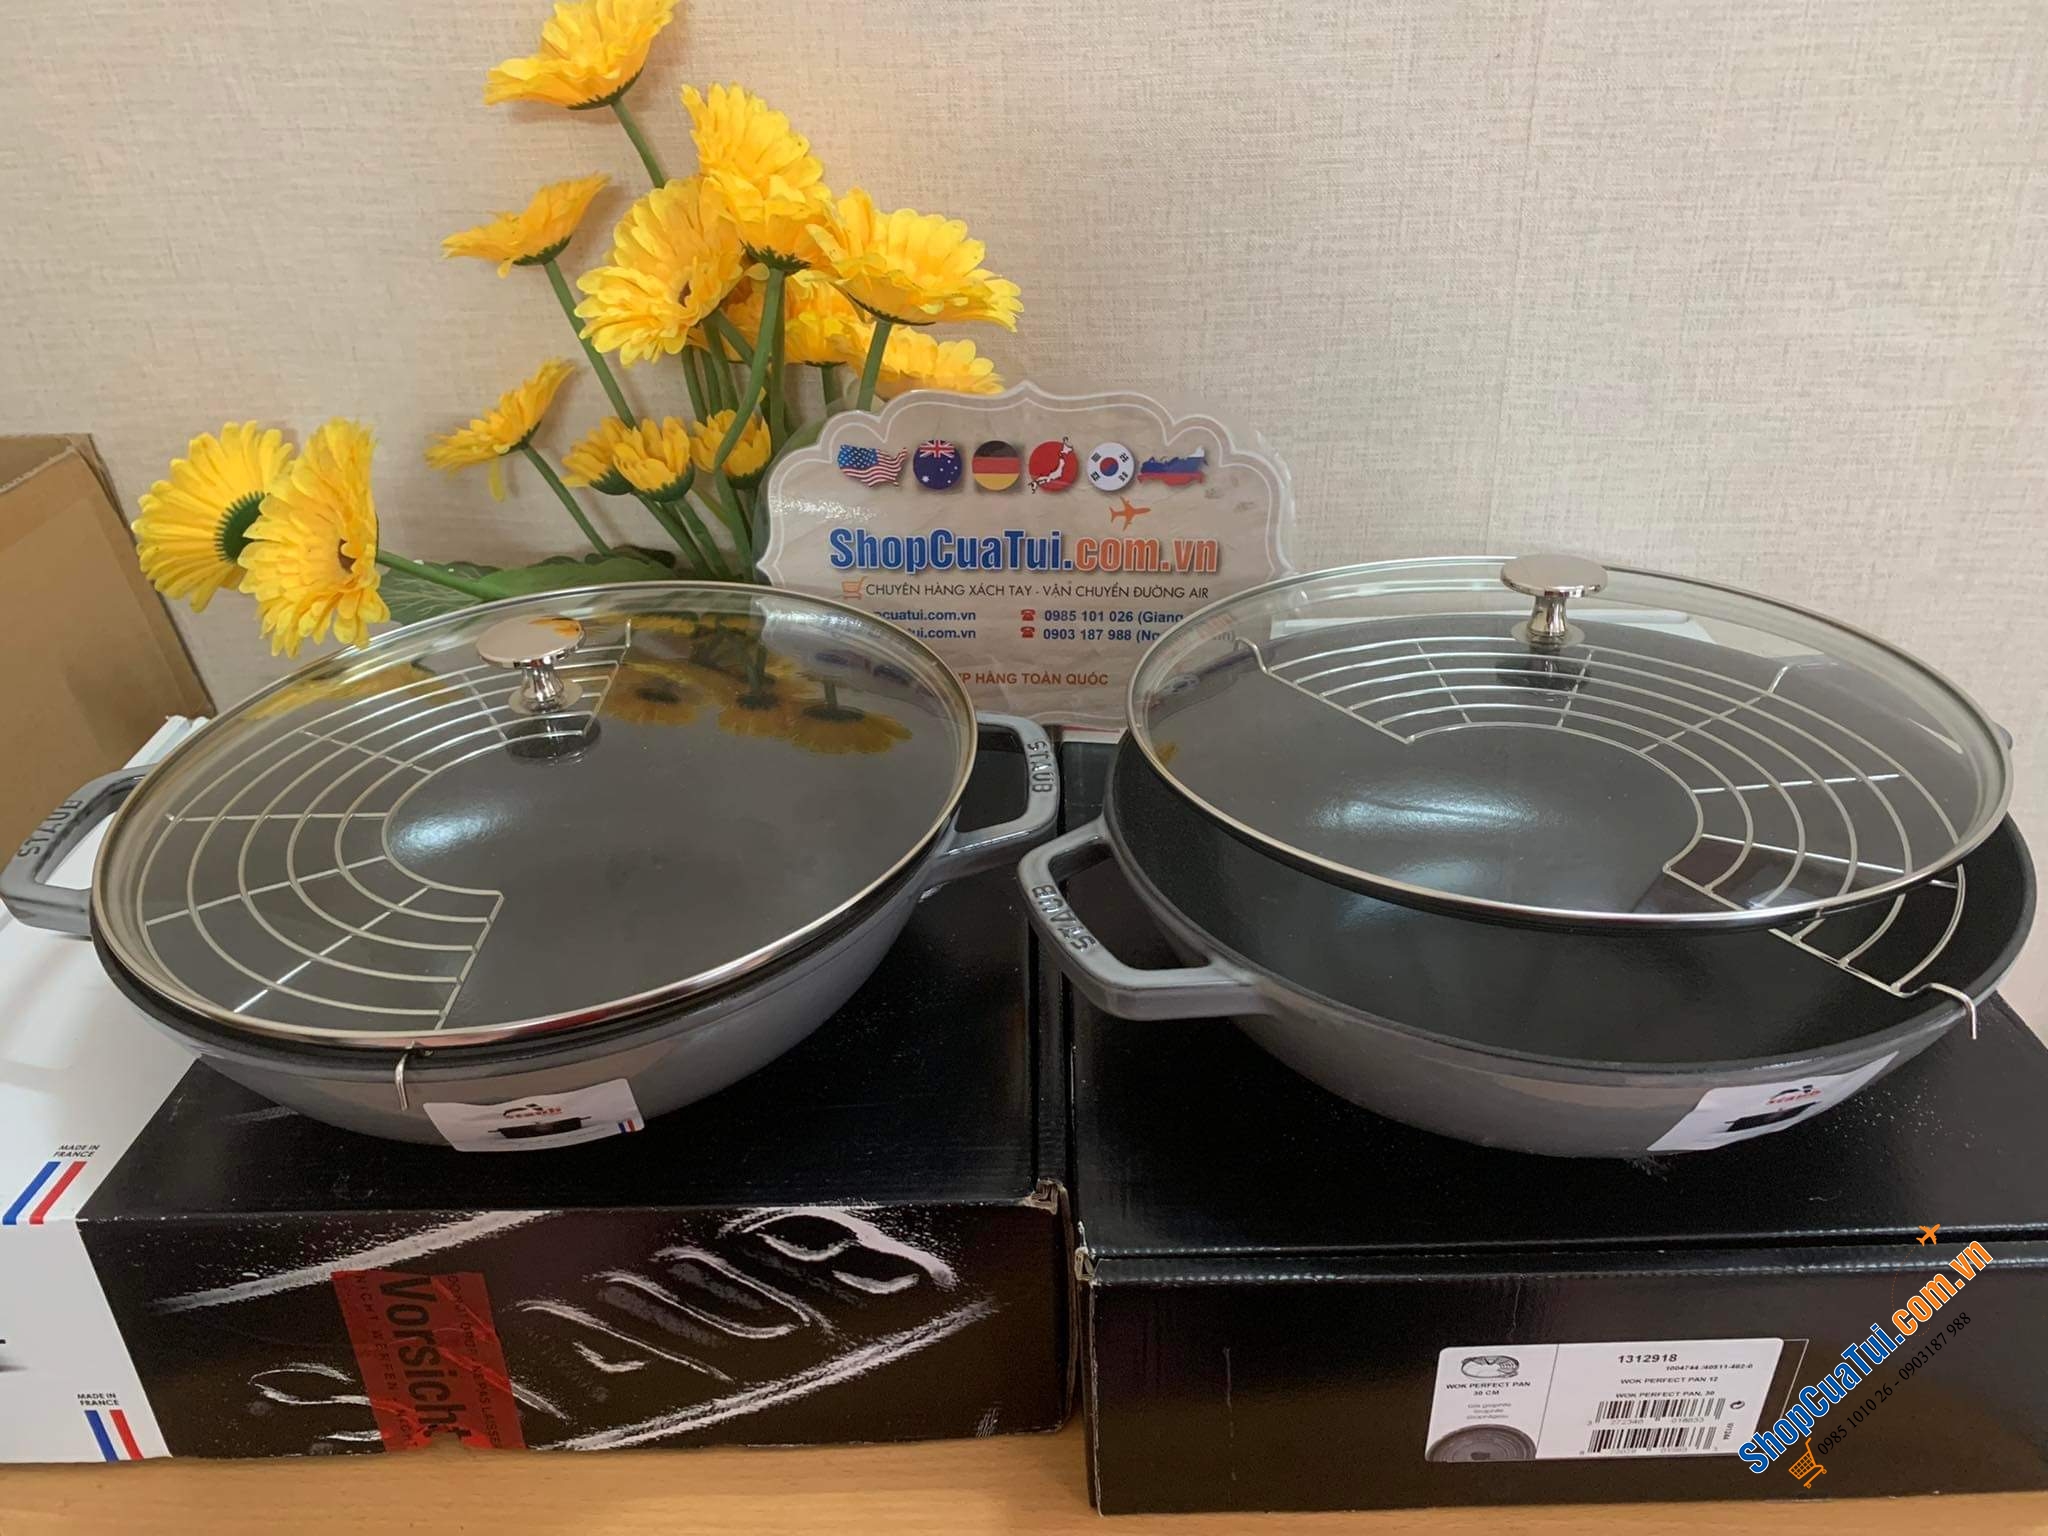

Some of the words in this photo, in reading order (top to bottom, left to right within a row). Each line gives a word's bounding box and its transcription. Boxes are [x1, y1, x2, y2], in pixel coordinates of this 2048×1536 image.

[829, 528, 1218, 574] ShopCuaTui.com.vn
[866, 582, 920, 596] CHUYÊN
[925, 582, 965, 596] HÀNG
[969, 582, 1005, 596] XÁCH
[1009, 585, 1032, 597] TAY
[1043, 582, 1072, 599] VẬN
[1189, 586, 1209, 599] AIR
[1044, 610, 1077, 622] 0985
[1081, 610, 1104, 622] 101
[1109, 611, 1134, 622] 026
[908, 628, 976, 639] ui.com.vn
[1043, 629, 1076, 640] 0903
[1080, 629, 1103, 640] 187
[1108, 630, 1132, 641] 988
[975, 670, 1018, 685] HÀNG
[1022, 671, 1062, 685] TOÀN
[1066, 671, 1109, 686] QUỐC
[1027, 740, 1053, 793] STAUB
[17, 799, 83, 857] STAUB
[1032, 884, 1097, 953] STAUB
[354, 1275, 379, 1322] NICHT
[371, 1329, 399, 1392] WERFEN
[1617, 1353, 1679, 1364] 1312918
